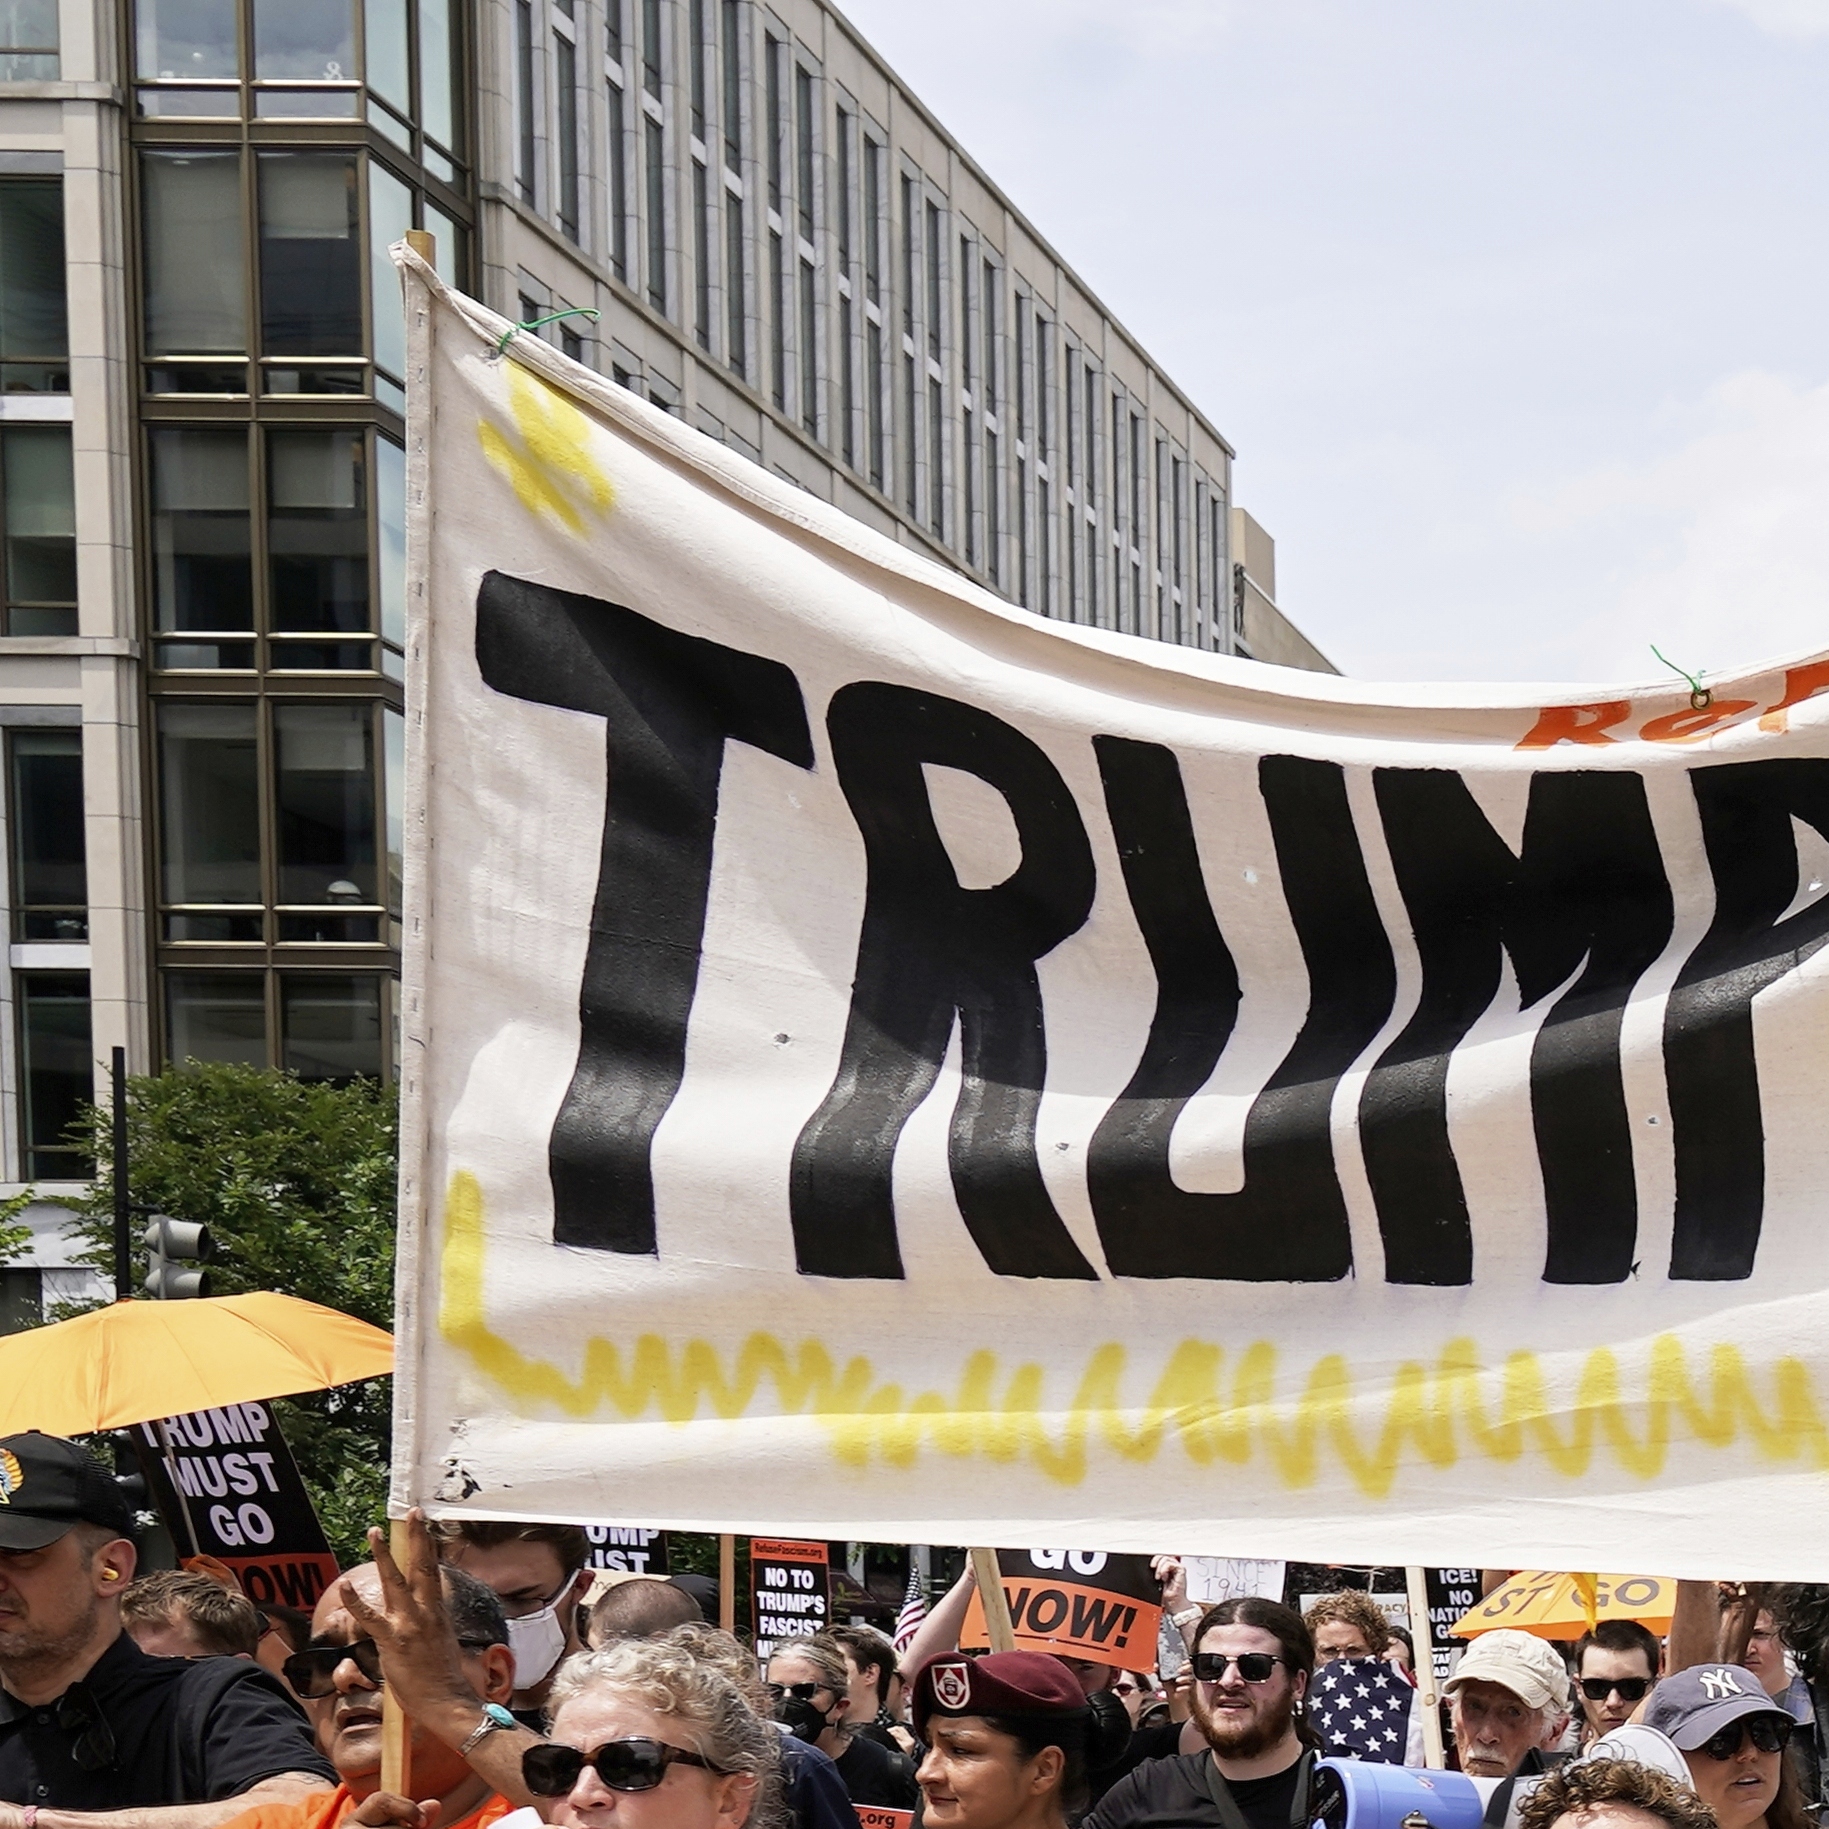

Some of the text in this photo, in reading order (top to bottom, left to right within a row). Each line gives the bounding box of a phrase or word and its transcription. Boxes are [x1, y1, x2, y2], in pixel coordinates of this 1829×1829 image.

[140, 1402, 271, 1448] TRUMP
[161, 1452, 281, 1498] MUST
[208, 1502, 276, 1547] GO
[231, 1560, 326, 1608] OW!
[764, 1567, 815, 1590] NO TO
[1439, 1568, 1479, 1585] ICE!
[756, 1590, 826, 1615] TRUMP'S
[1448, 1589, 1474, 1606] NO
[759, 1615, 825, 1638] FASCIST
[1003, 1586, 1138, 1649] NOW!
